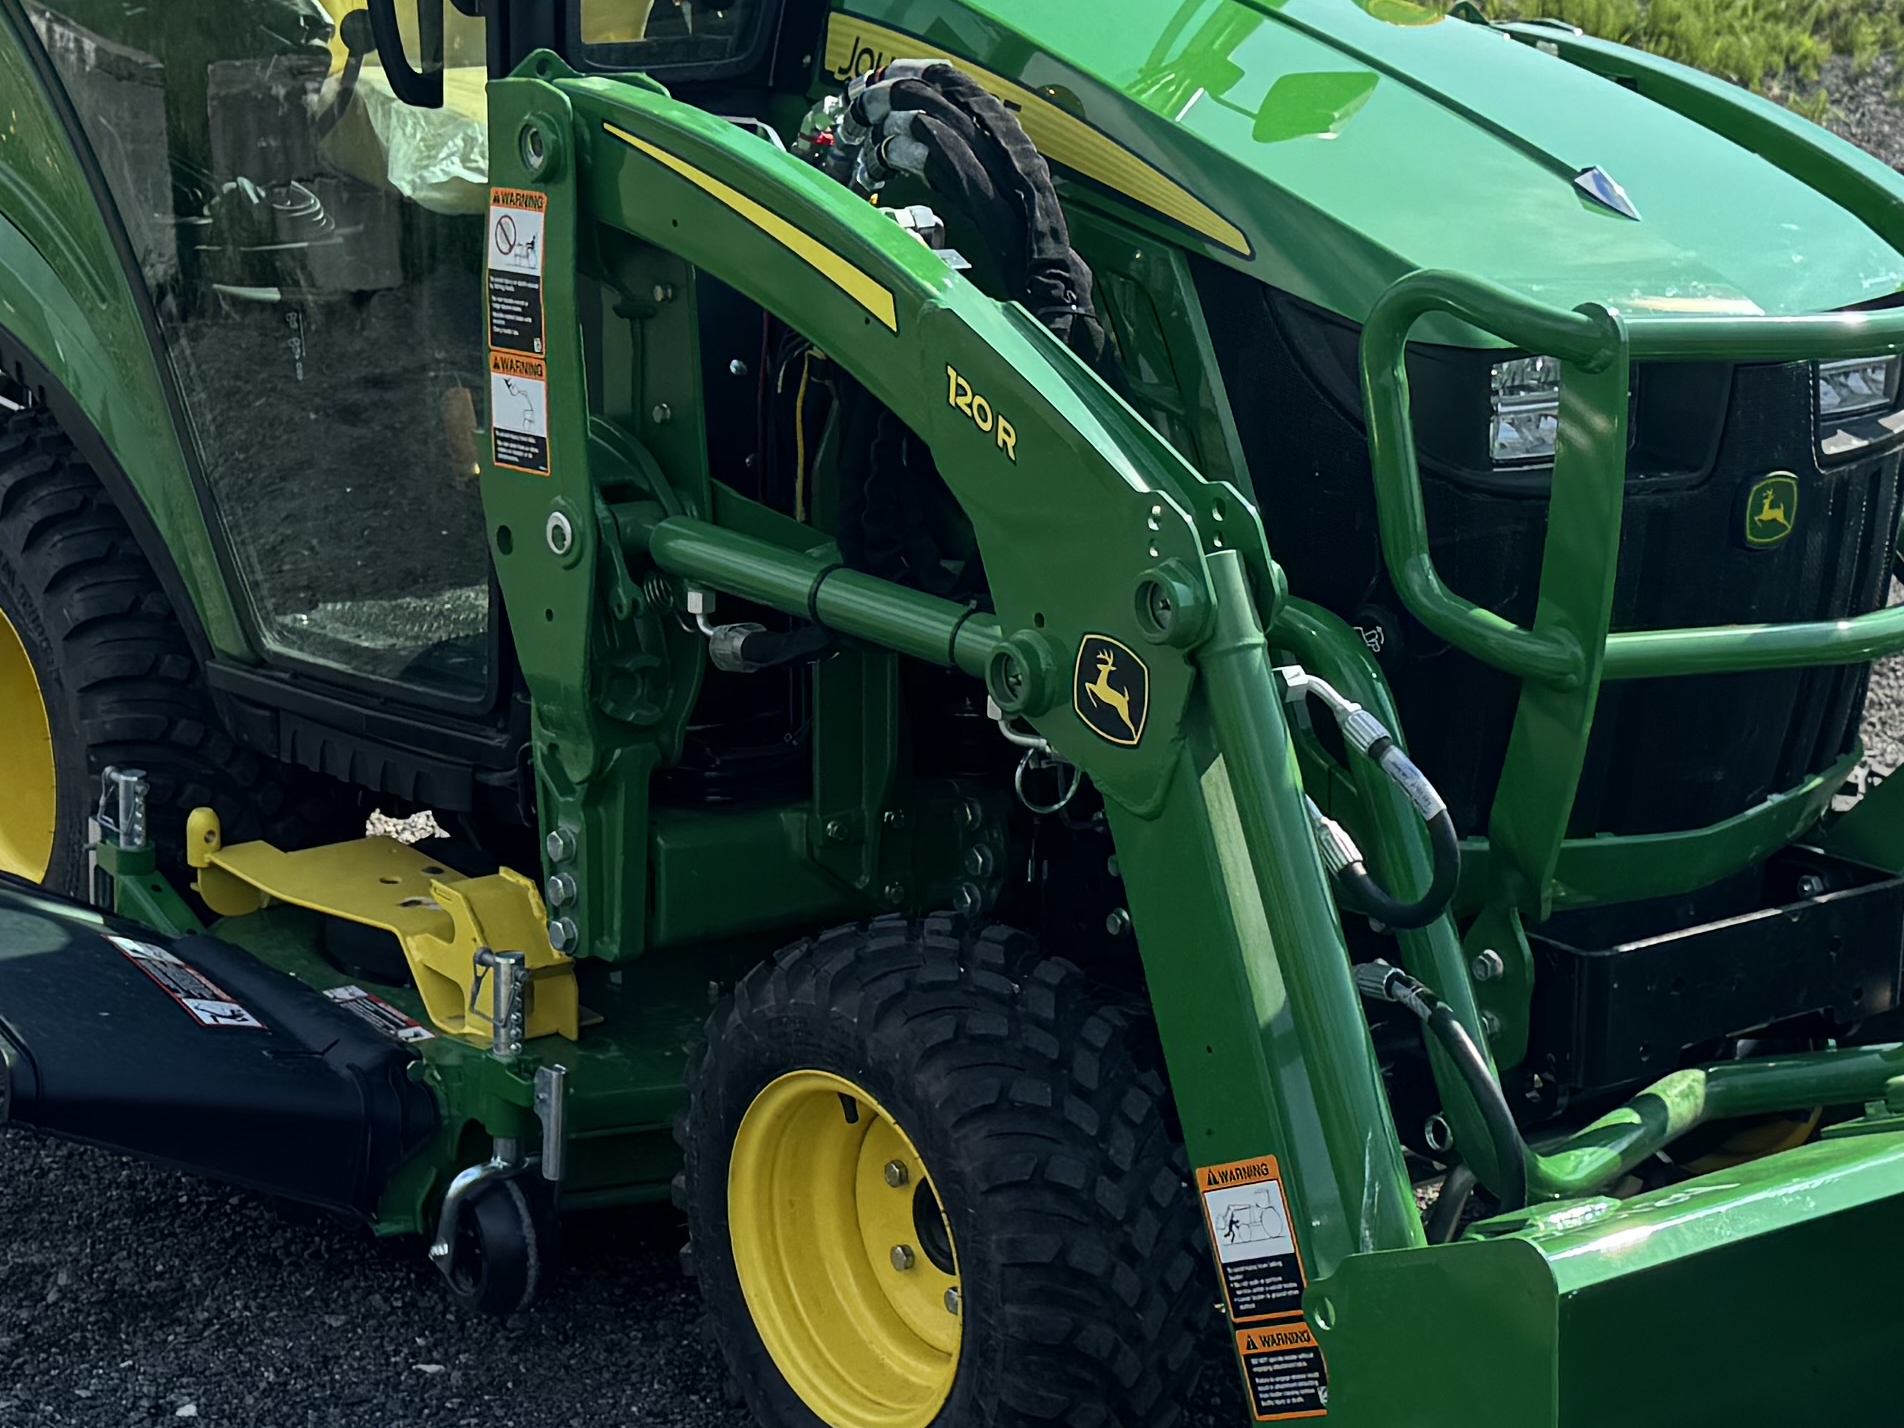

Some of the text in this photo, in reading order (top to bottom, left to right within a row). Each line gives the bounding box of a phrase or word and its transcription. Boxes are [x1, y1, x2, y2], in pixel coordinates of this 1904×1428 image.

[501, 191, 544, 209] WARNING
[500, 357, 544, 377] WARNING
[1218, 1162, 1271, 1184] WARNING
[1258, 1328, 1312, 1349] WARNING
